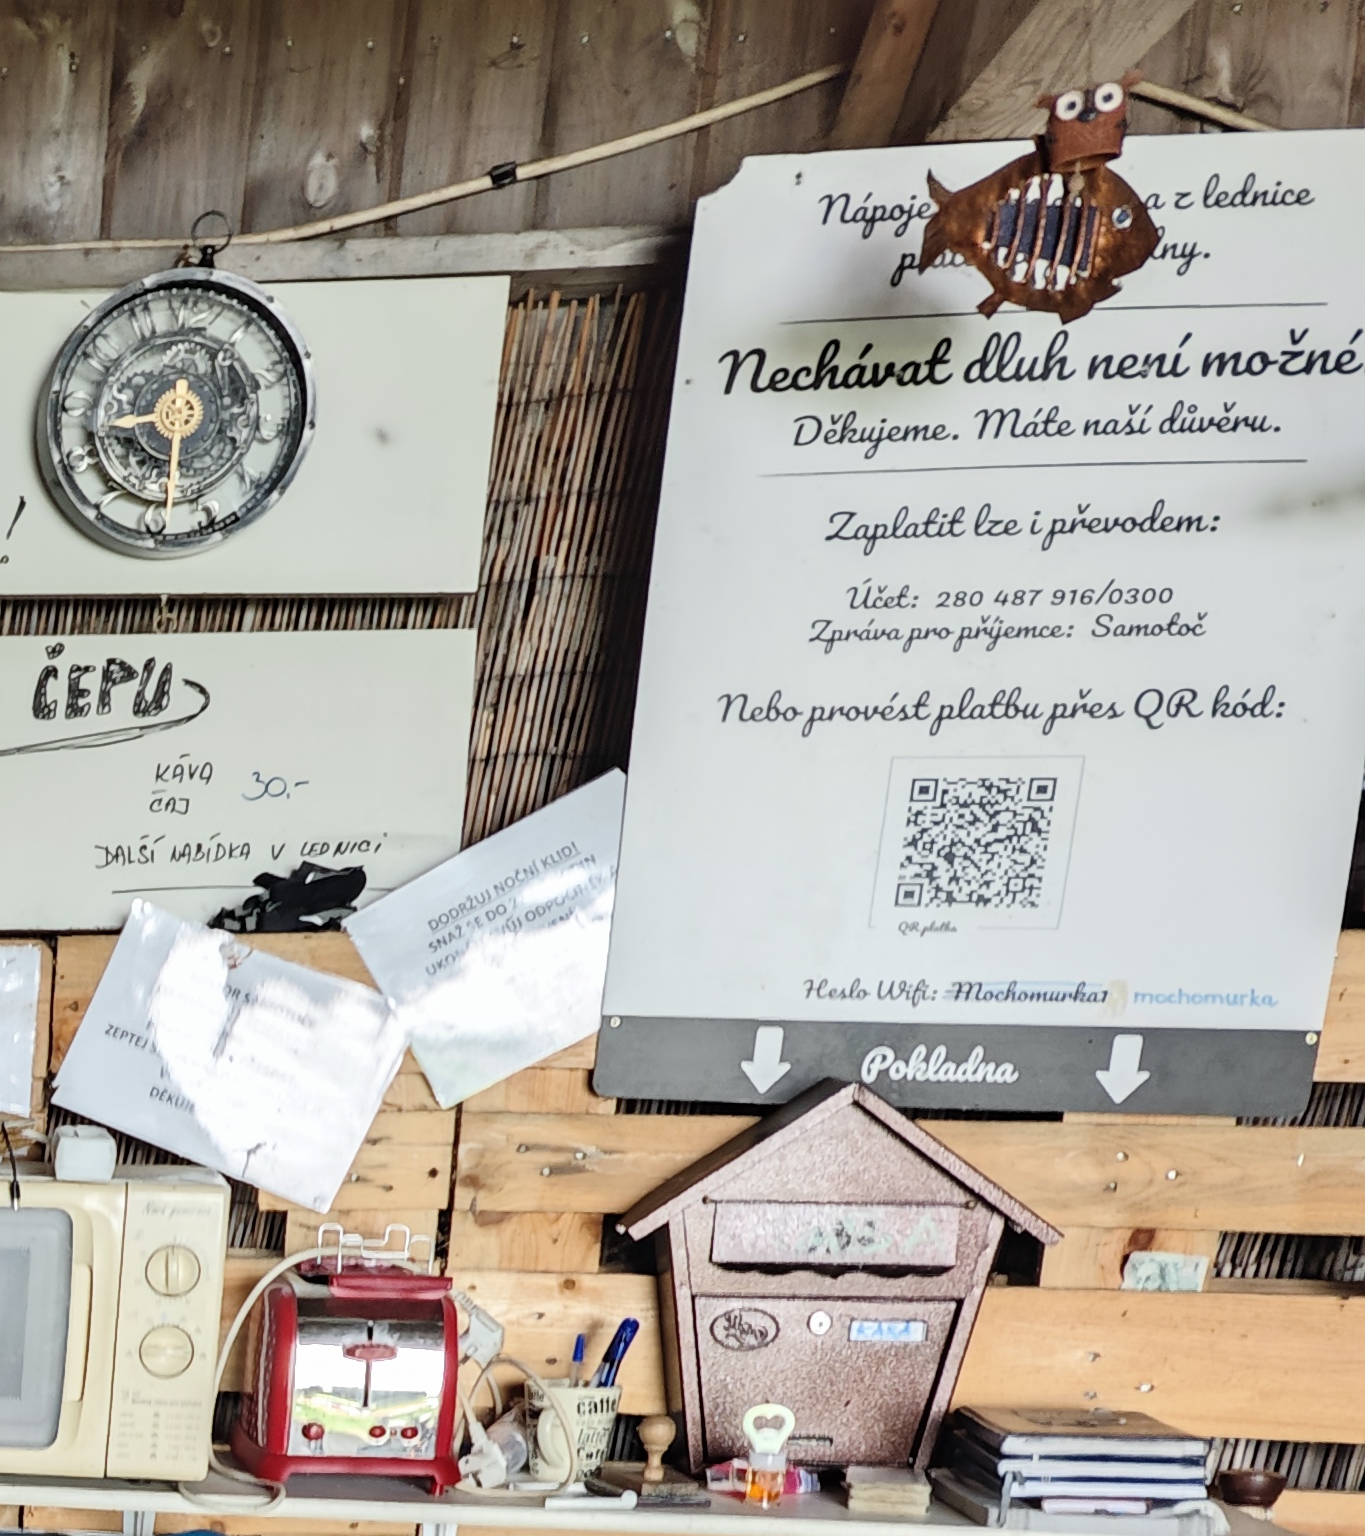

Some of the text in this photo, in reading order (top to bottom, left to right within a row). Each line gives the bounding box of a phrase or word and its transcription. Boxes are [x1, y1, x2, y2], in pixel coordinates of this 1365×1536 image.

[819, 192, 933, 239] Nápoje
[1202, 173, 1316, 209] lednice
[718, 338, 952, 395] Nechávat
[963, 331, 1074, 386] dluh
[1087, 334, 1190, 381] není
[793, 401, 1282, 459] Děkujeme. Máte naší důvěru.
[825, 499, 1221, 556] Zaplatit lze i převodem:
[846, 577, 1175, 610] Účet: 280 487 916/0300
[808, 612, 1207, 655] Zpráva pro příjemce: Samotoč
[31, 642, 172, 720] ČEPU
[717, 685, 1286, 737] Nebo provést platbu přes QR kód:
[154, 754, 214, 785] KÁVA
[95, 835, 166, 869] DALŠÍ
[169, 833, 251, 865] NABÍDKA
[270, 843, 285, 861] V
[427, 887, 493, 933] DODRŽUJ
[494, 859, 540, 896] NOČNÍ
[540, 840, 581, 871] KLID!
[428, 928, 464, 954] SNAŽ
[485, 903, 508, 923] DO
[802, 978, 871, 999] Heslo
[877, 978, 938, 1008] Wifi:
[1132, 988, 1280, 1008] mochomurka
[861, 1043, 1020, 1084] Pokladna
